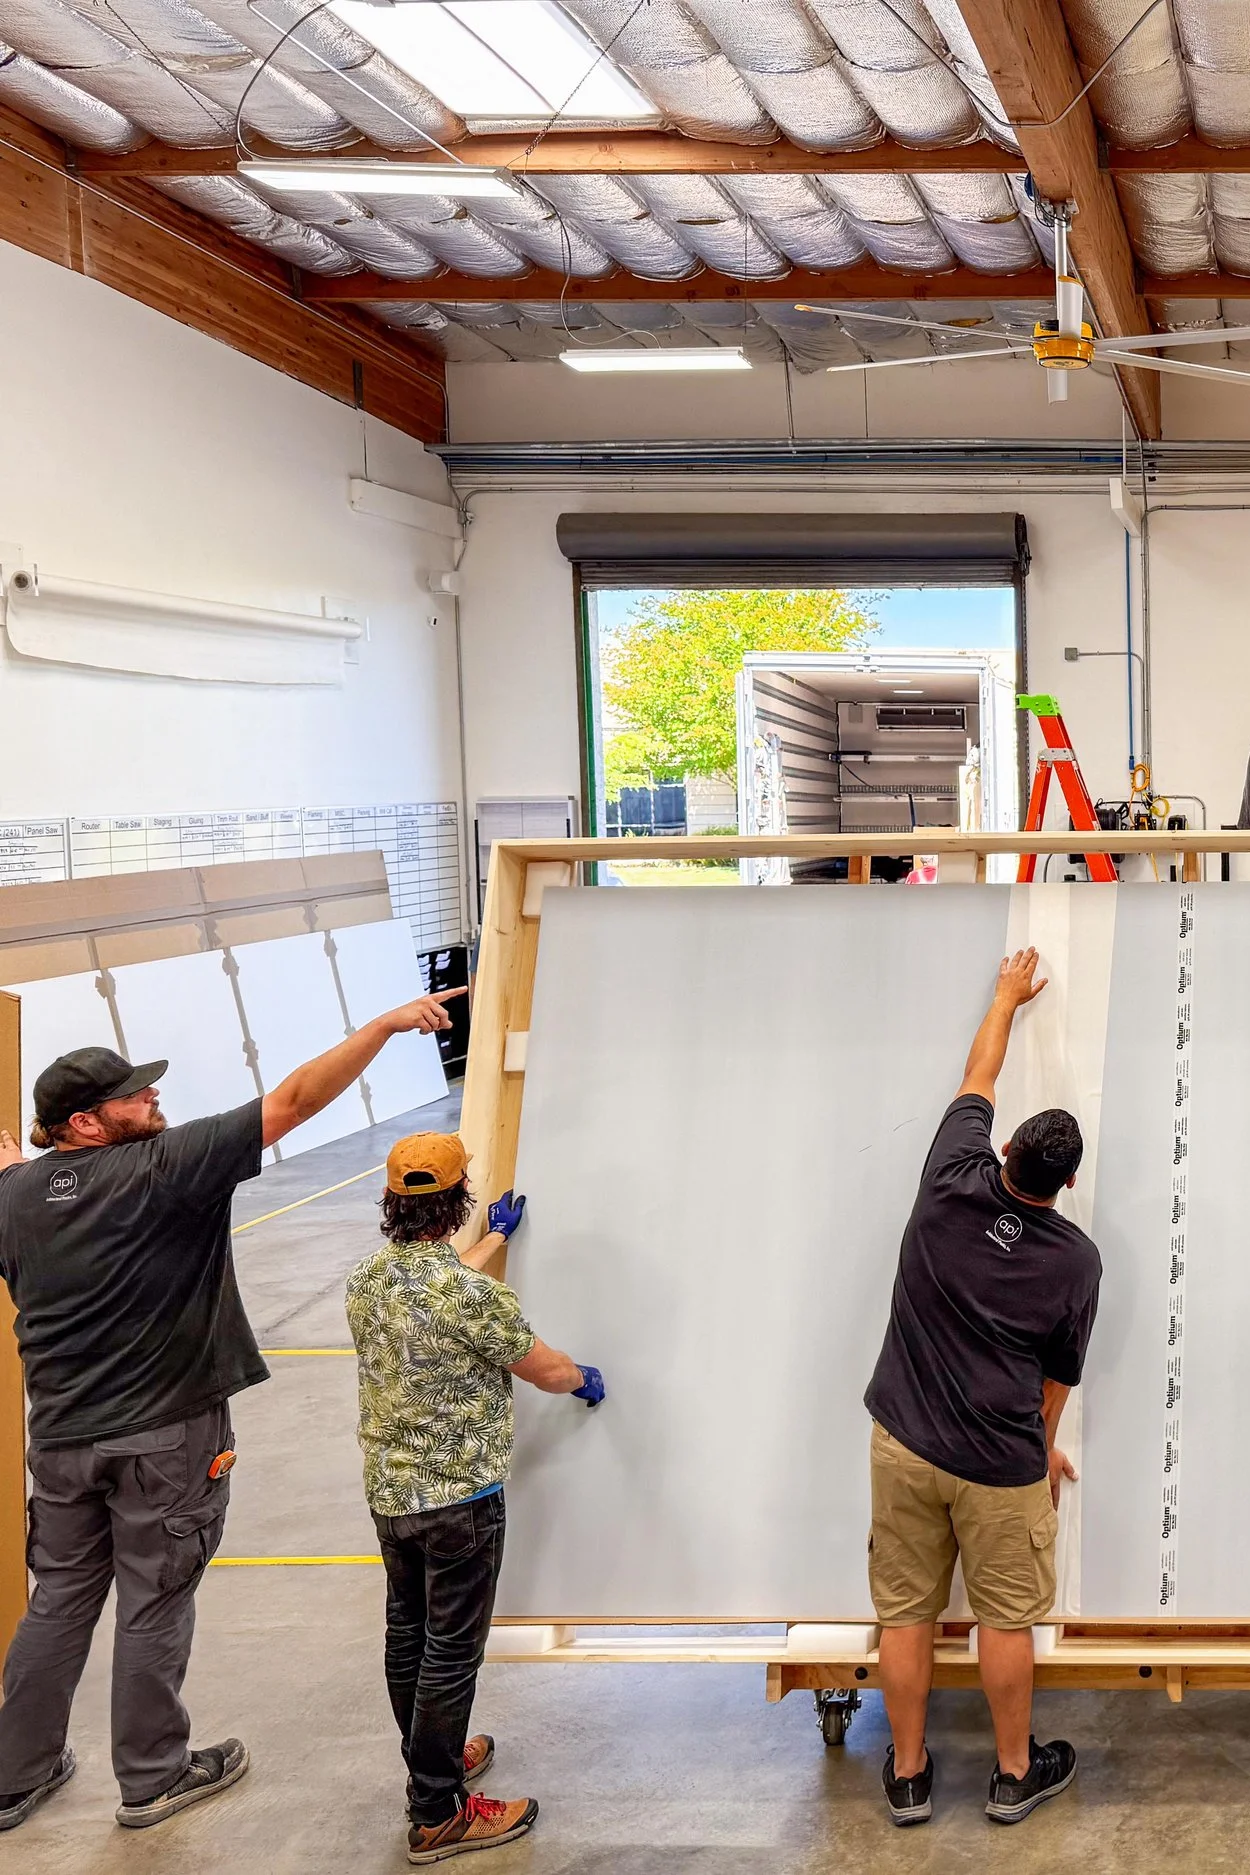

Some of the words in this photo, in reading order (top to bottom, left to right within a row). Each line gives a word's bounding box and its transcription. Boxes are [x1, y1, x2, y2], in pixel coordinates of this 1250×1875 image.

[27, 827, 44, 835] Panel
[46, 826, 58, 834] Saw
[82, 822, 100, 830] Router
[1179, 912, 1187, 938] Optium
[1178, 966, 1186, 994] Optium
[1176, 1022, 1184, 1050] Optium
[1175, 1078, 1183, 1106] Optium
[1173, 1136, 1181, 1164] Optium
[53, 1175, 74, 1190] api
[1172, 1196, 1180, 1224] Optium
[999, 1220, 1020, 1237] api
[1170, 1254, 1178, 1284] Optium
[1168, 1316, 1176, 1346] Optium
[1166, 1378, 1174, 1408] Optium
[1164, 1442, 1172, 1472] Optium
[1162, 1506, 1170, 1538] Optium
[1160, 1572, 1168, 1606] Optium
